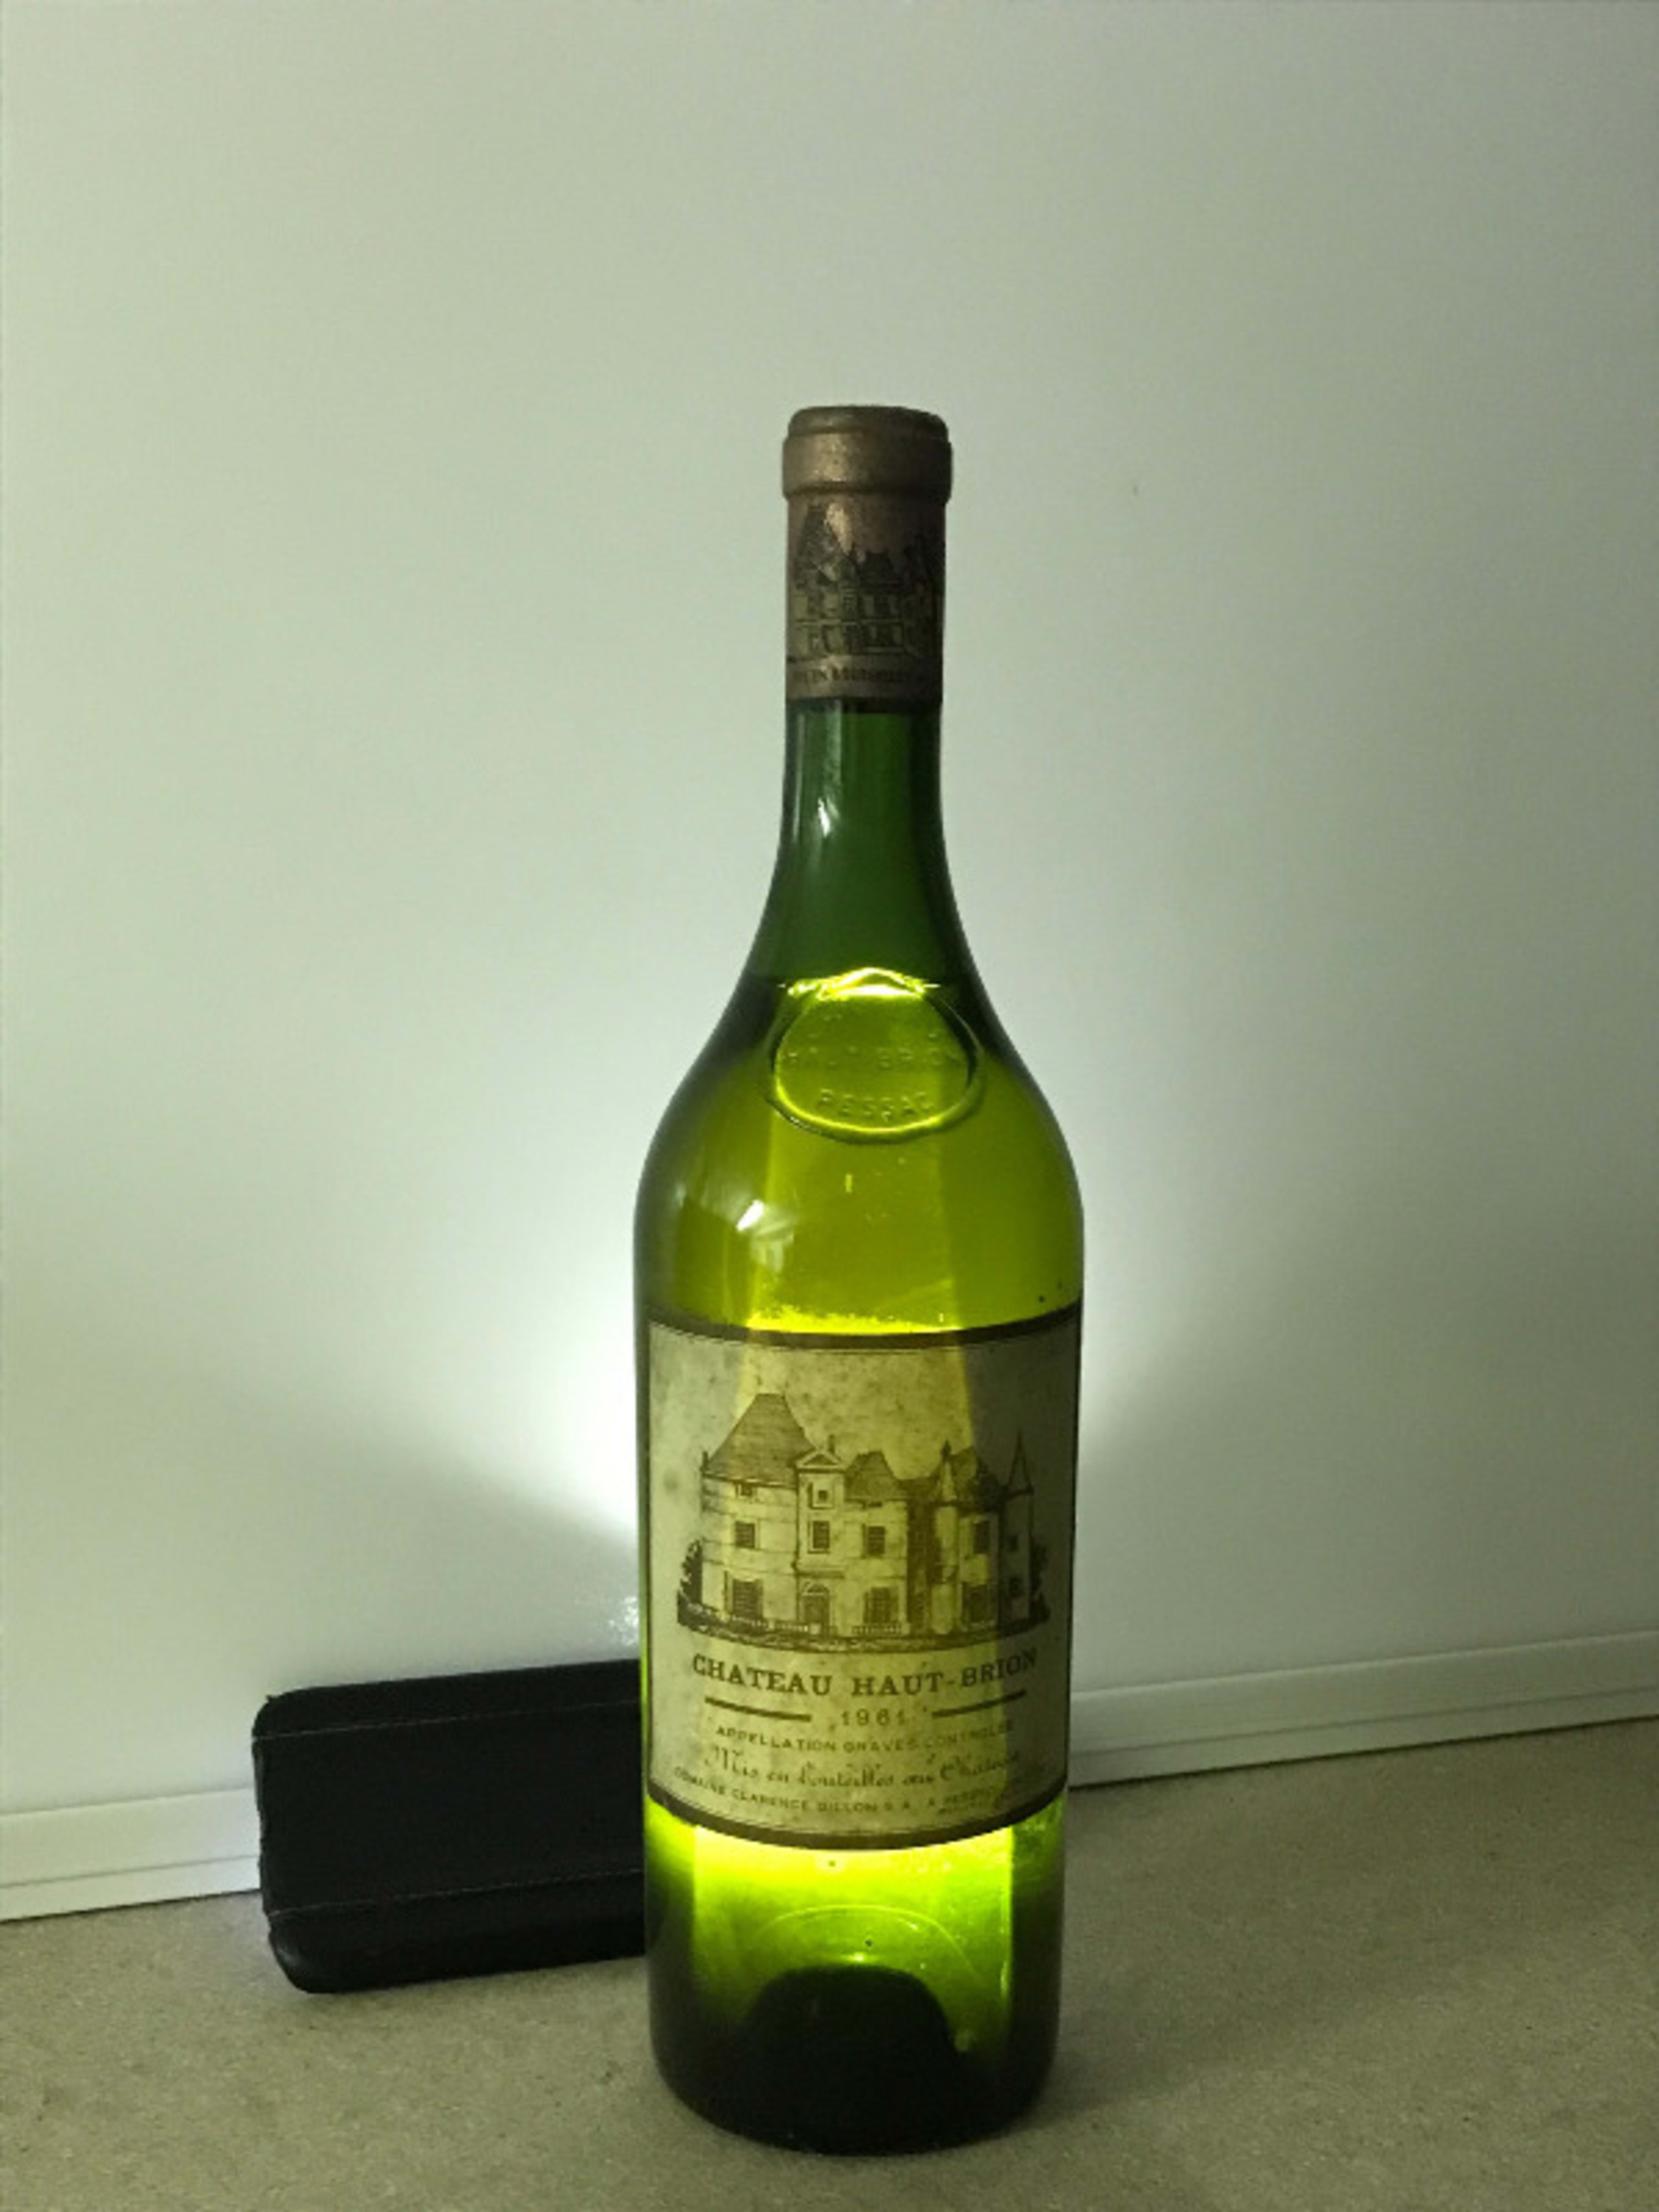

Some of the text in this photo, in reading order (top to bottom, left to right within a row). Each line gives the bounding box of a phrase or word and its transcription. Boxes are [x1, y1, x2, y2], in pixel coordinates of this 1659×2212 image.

[692, 1653, 833, 1696] CHATEAU
[841, 1708, 905, 1727] 1961
[715, 1725, 837, 1751] APPELLATION
[842, 1737, 918, 1754] GRAVES
[731, 1788, 810, 1812] CLARENCE
[817, 1802, 879, 1813] DILLON
